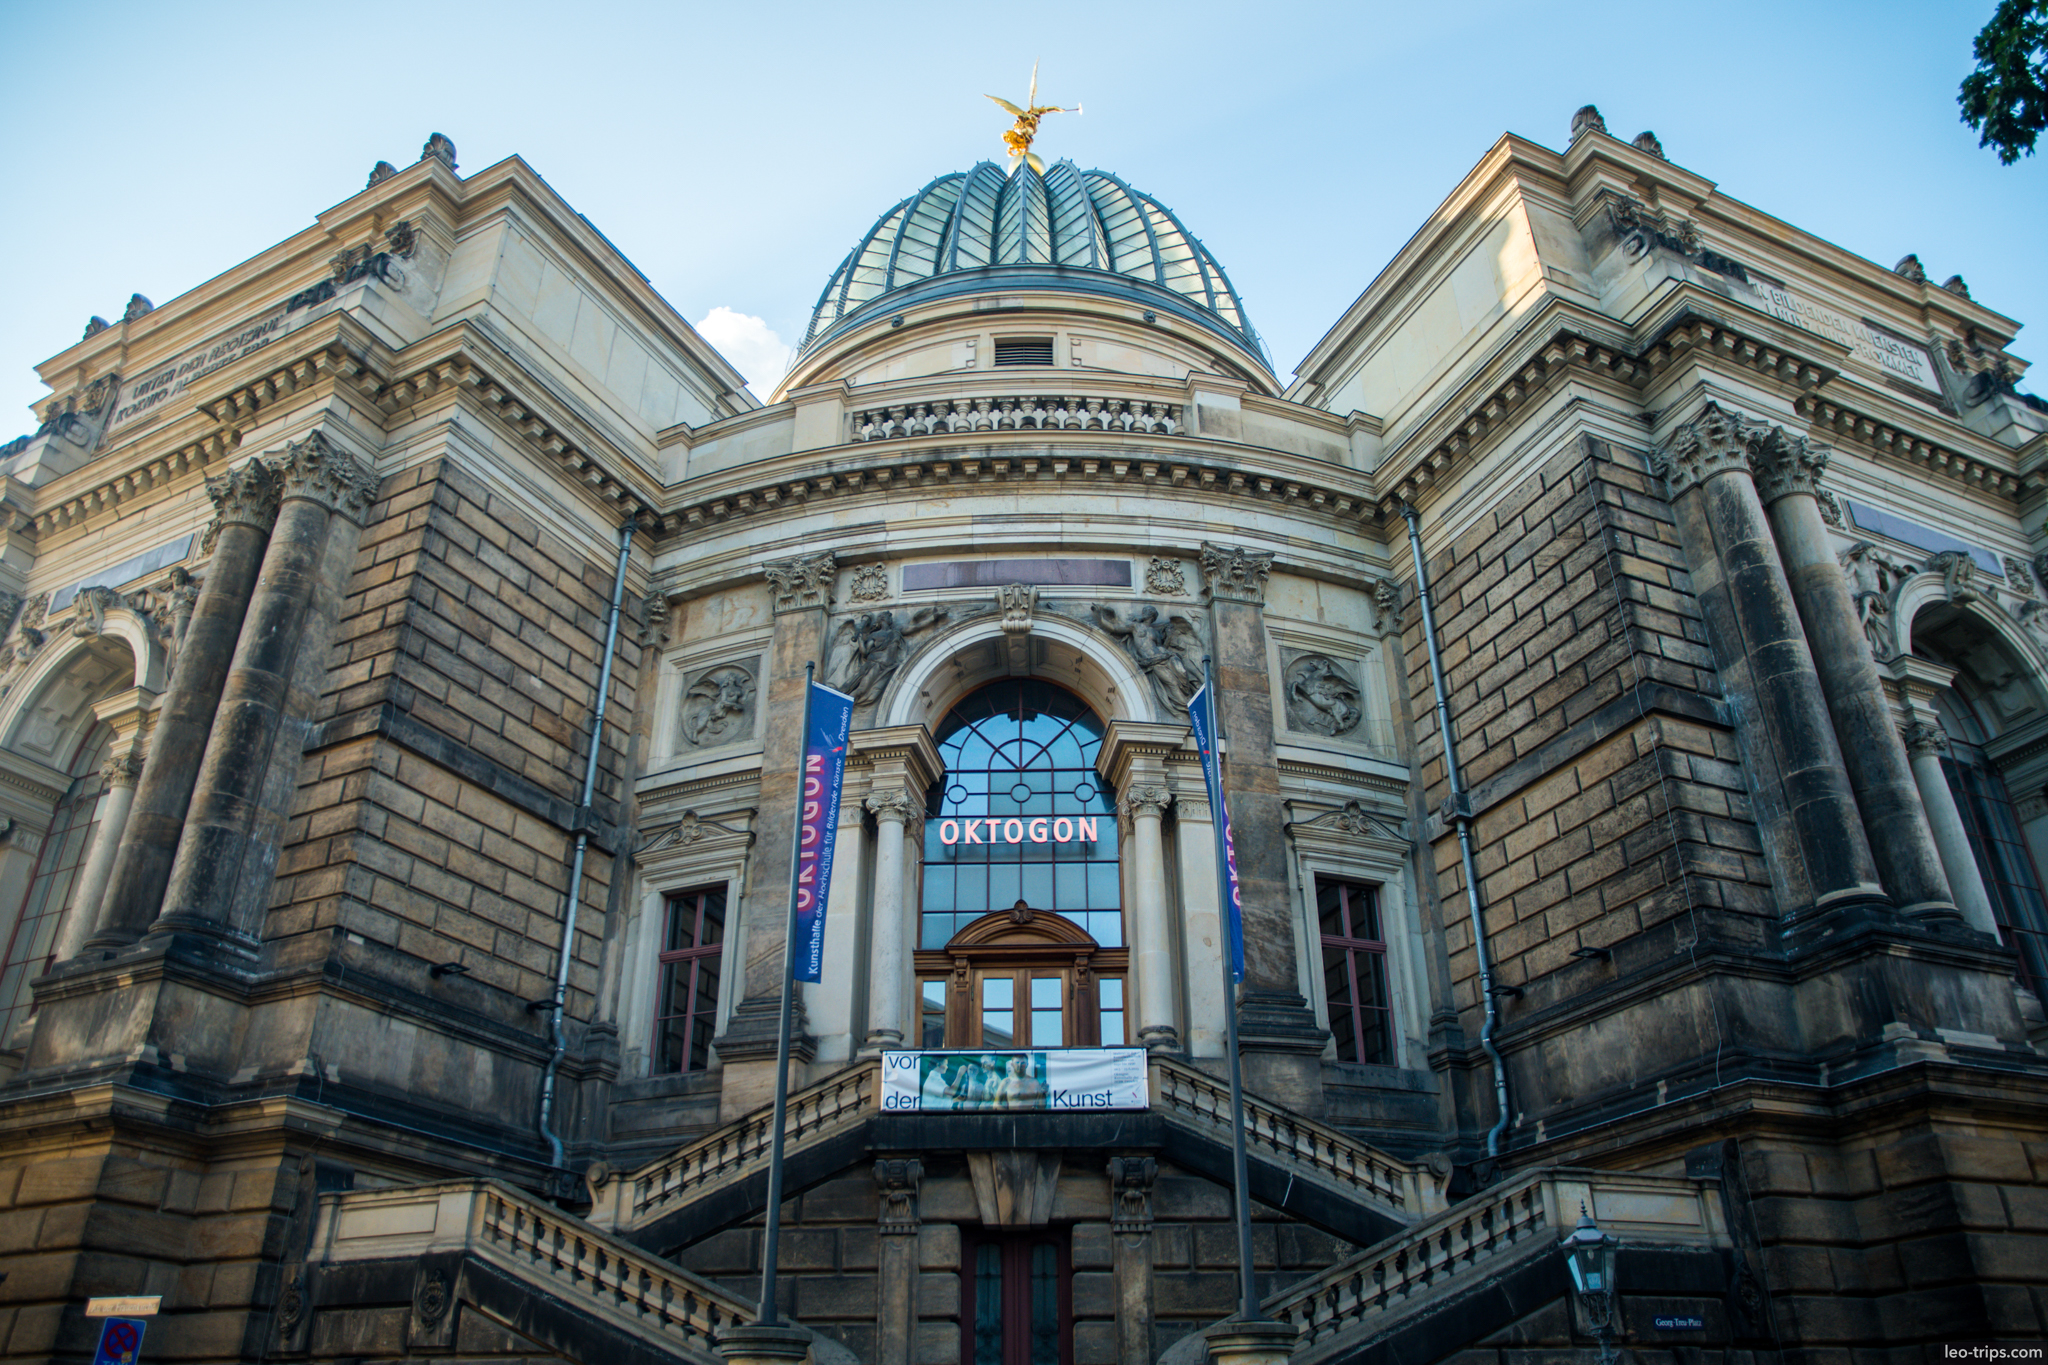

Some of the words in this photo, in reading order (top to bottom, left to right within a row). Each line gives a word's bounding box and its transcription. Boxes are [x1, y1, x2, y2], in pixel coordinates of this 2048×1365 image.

[208, 314, 283, 362] REGIERUN
[838, 706, 849, 742] Dresden
[832, 757, 842, 788] Künste
[826, 790, 838, 830] Bildende
[824, 831, 834, 848] für
[939, 817, 1098, 845] OKTOGON
[818, 849, 832, 899] Hochschule
[816, 901, 824, 918] der
[808, 919, 822, 975] Kunsthalle
[888, 1055, 921, 1070] vor
[885, 1090, 920, 1109] der
[1053, 1089, 1113, 1108] Kunst
